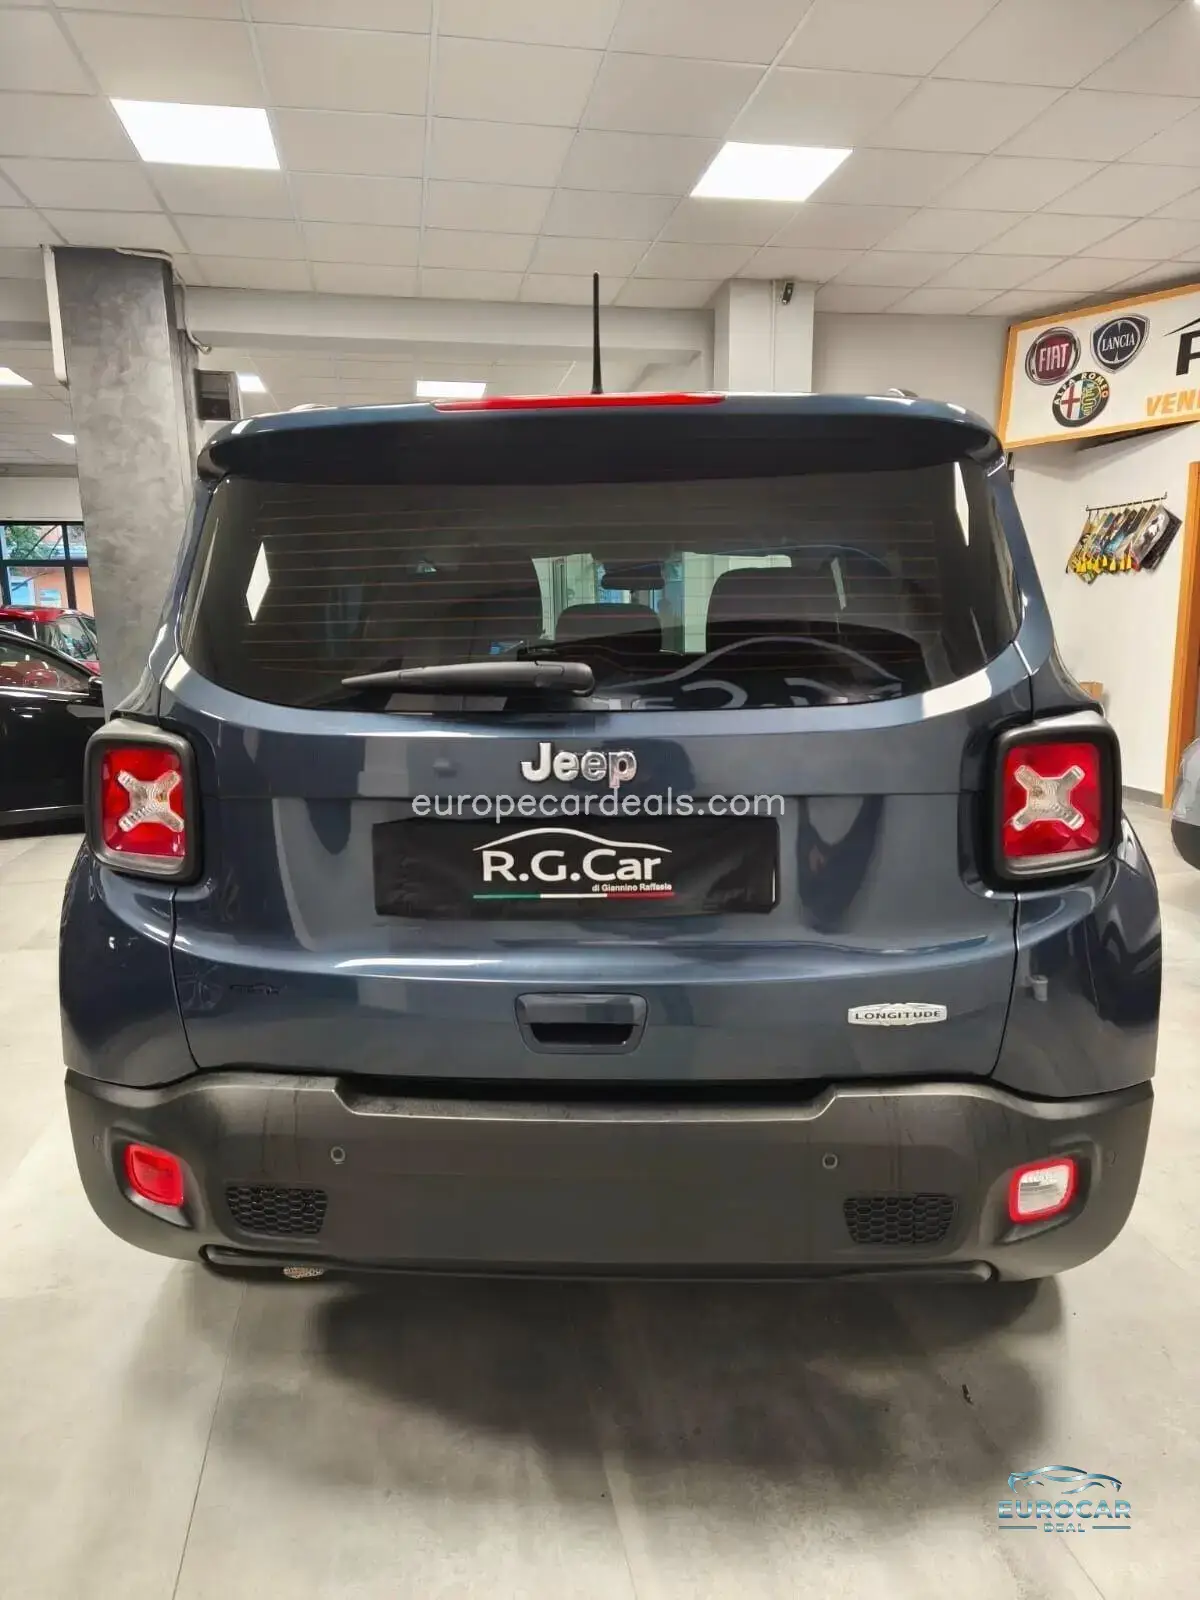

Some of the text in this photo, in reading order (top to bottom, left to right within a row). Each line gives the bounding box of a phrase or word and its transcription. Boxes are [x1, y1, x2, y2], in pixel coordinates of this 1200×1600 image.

[1102, 334, 1136, 351] LANCIA
[1038, 343, 1069, 372] FIAT
[1053, 372, 1109, 405] ALFA ROMEO
[1146, 389, 1200, 416] VEN
[521, 742, 637, 788] Jeep
[482, 849, 661, 882] R.G.Car
[592, 884, 600, 892] di
[855, 1010, 941, 1020] LONGITUDE
